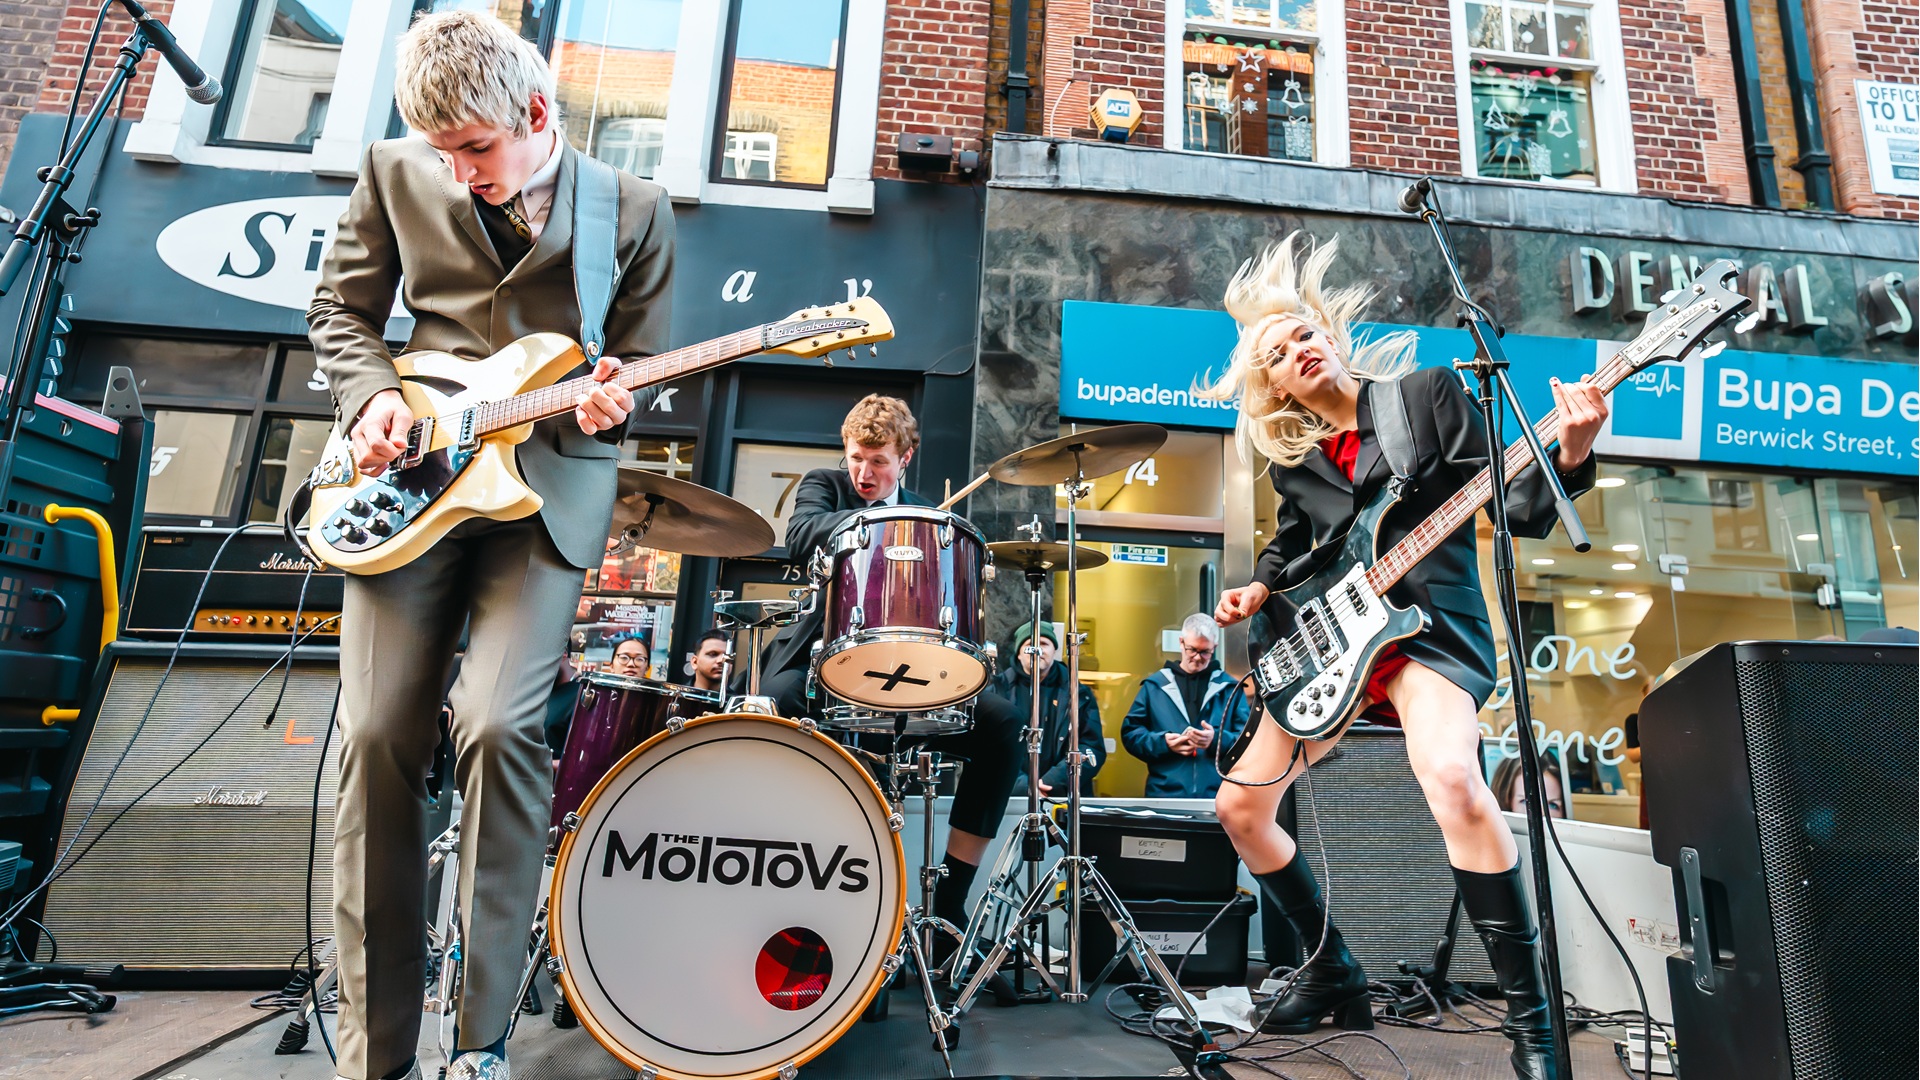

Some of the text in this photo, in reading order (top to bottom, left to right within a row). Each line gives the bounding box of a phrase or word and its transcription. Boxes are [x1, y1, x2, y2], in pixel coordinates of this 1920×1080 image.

[1108, 102, 1130, 114] ADT
[1866, 100, 1895, 121] TO
[1875, 124, 1891, 133] ALL
[217, 211, 326, 279] Si
[1576, 246, 1829, 329] DENAL
[776, 319, 852, 339] Rickenbacker
[1627, 371, 1656, 385] upa
[1718, 367, 1919, 422] Bupa De
[1716, 423, 1815, 450] Berwick
[1822, 430, 1903, 460] Street,
[150, 446, 179, 477] 5
[771, 472, 802, 518] 7
[1128, 545, 1143, 554] Fire
[259, 552, 319, 571] Marsha
[781, 564, 801, 581] 75
[194, 785, 268, 806] Marshall
[661, 833, 700, 845] THE
[1138, 849, 1162, 857] LEADS
[1159, 943, 1181, 952] LEADS
